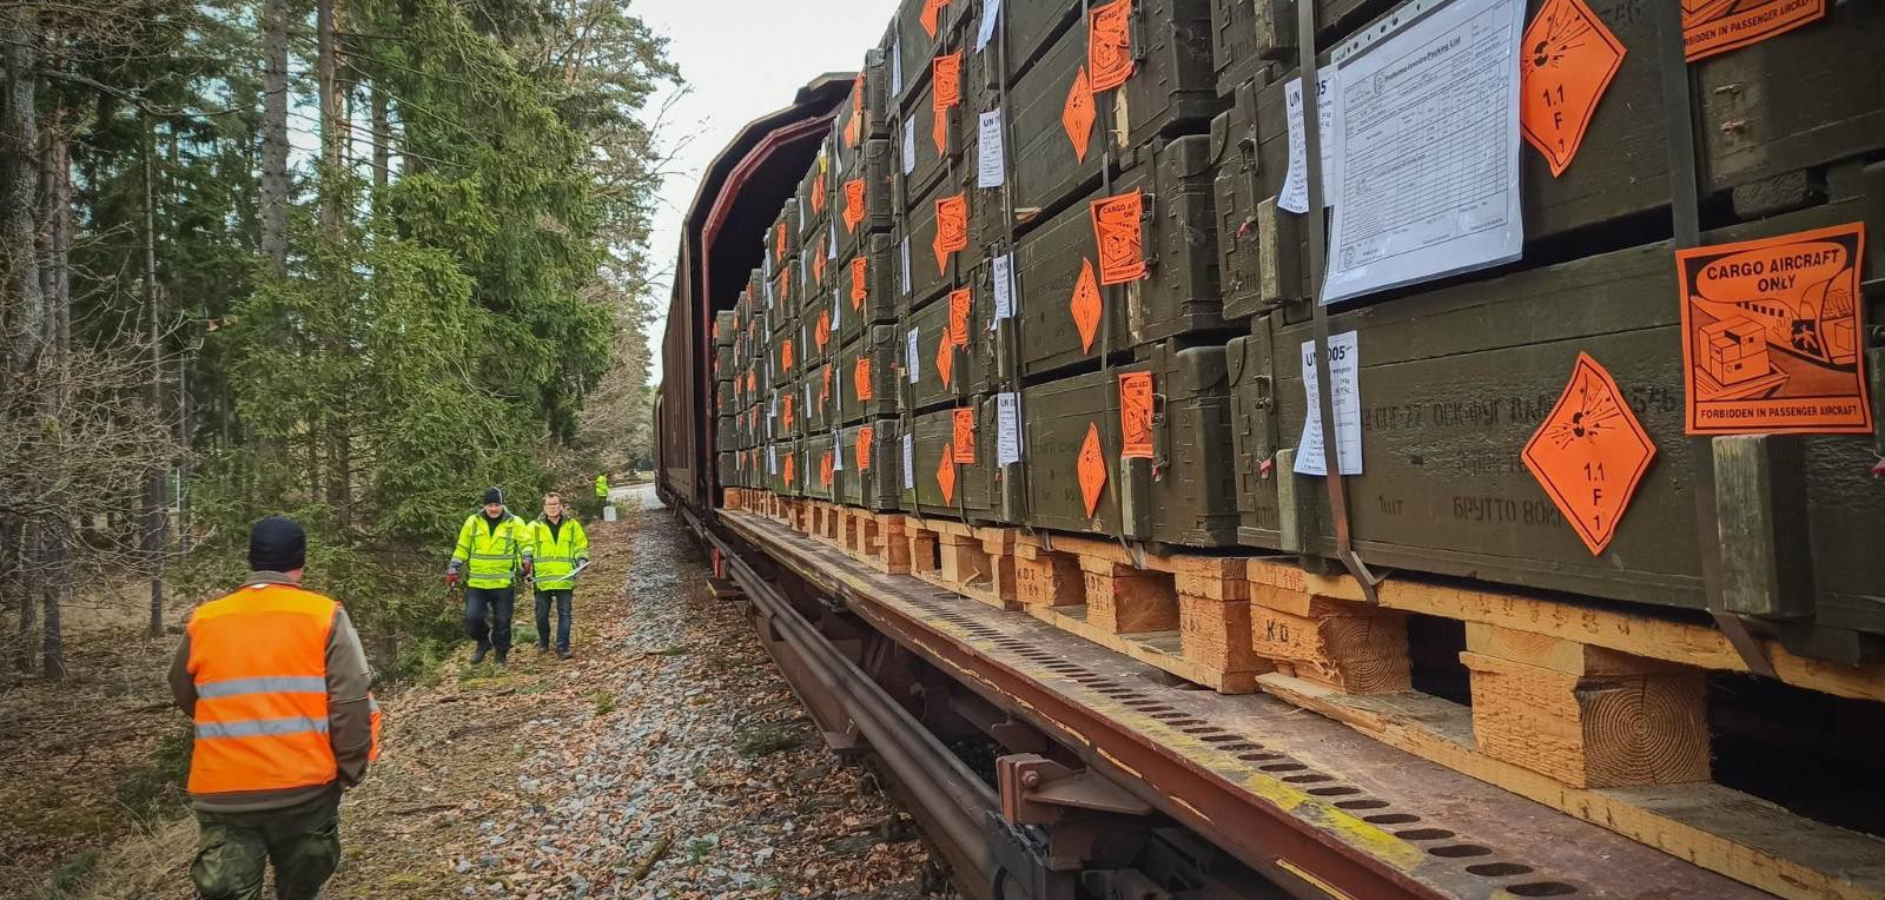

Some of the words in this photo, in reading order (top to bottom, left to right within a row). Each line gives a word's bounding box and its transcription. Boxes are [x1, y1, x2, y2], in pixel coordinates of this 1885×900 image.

[1684, 29, 1717, 47] RBIDDEN
[1718, 25, 1728, 36] IN
[1730, 9, 1778, 32] PASSENGER
[1543, 84, 1564, 107] 1.1
[1554, 111, 1562, 130] F
[1558, 138, 1565, 153] 1
[1707, 260, 1765, 281] CARGO
[1769, 249, 1840, 274] AIRCRAFT
[1757, 274, 1796, 293] ONLY
[1700, 408, 1754, 419] FORBIDDEN
[1756, 408, 1766, 417] IN
[1768, 405, 1818, 418] PASSENGER
[1820, 404, 1857, 416] AIRCRAFT
[1584, 462, 1605, 481] 1.1
[1593, 488, 1602, 506] F
[1593, 514, 1600, 531] 1
